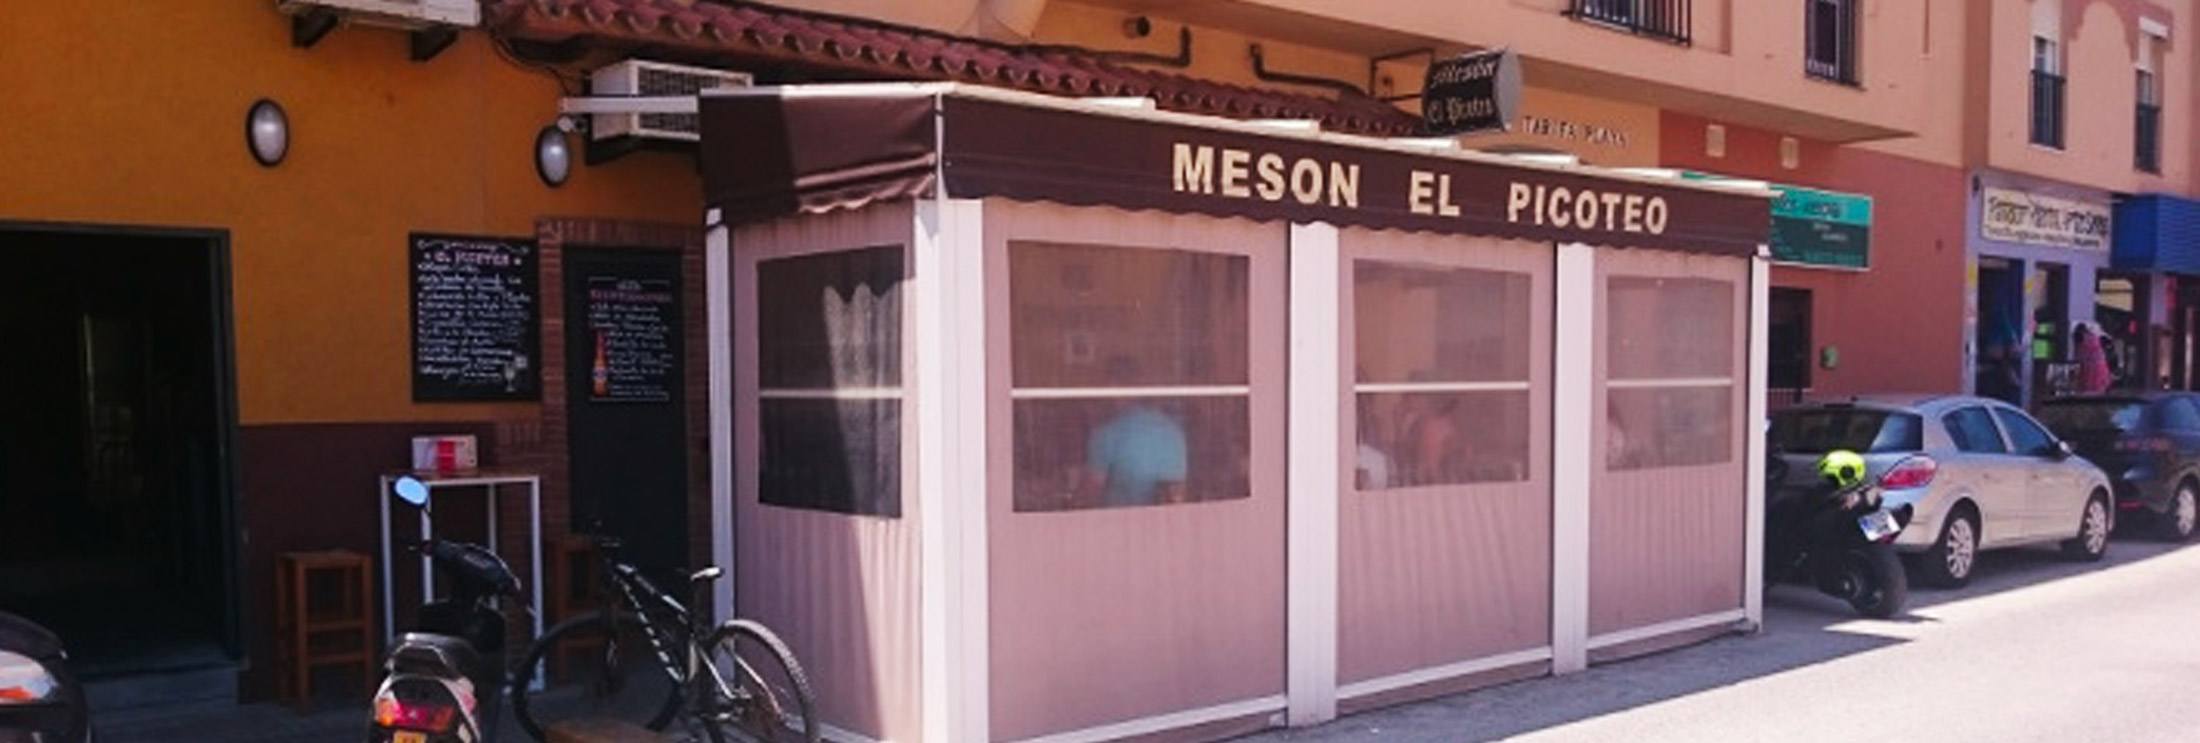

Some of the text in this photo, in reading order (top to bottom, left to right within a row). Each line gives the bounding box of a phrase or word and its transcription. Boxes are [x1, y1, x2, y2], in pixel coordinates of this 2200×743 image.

[1172, 143, 1668, 236] MESON EL PICOTEO
